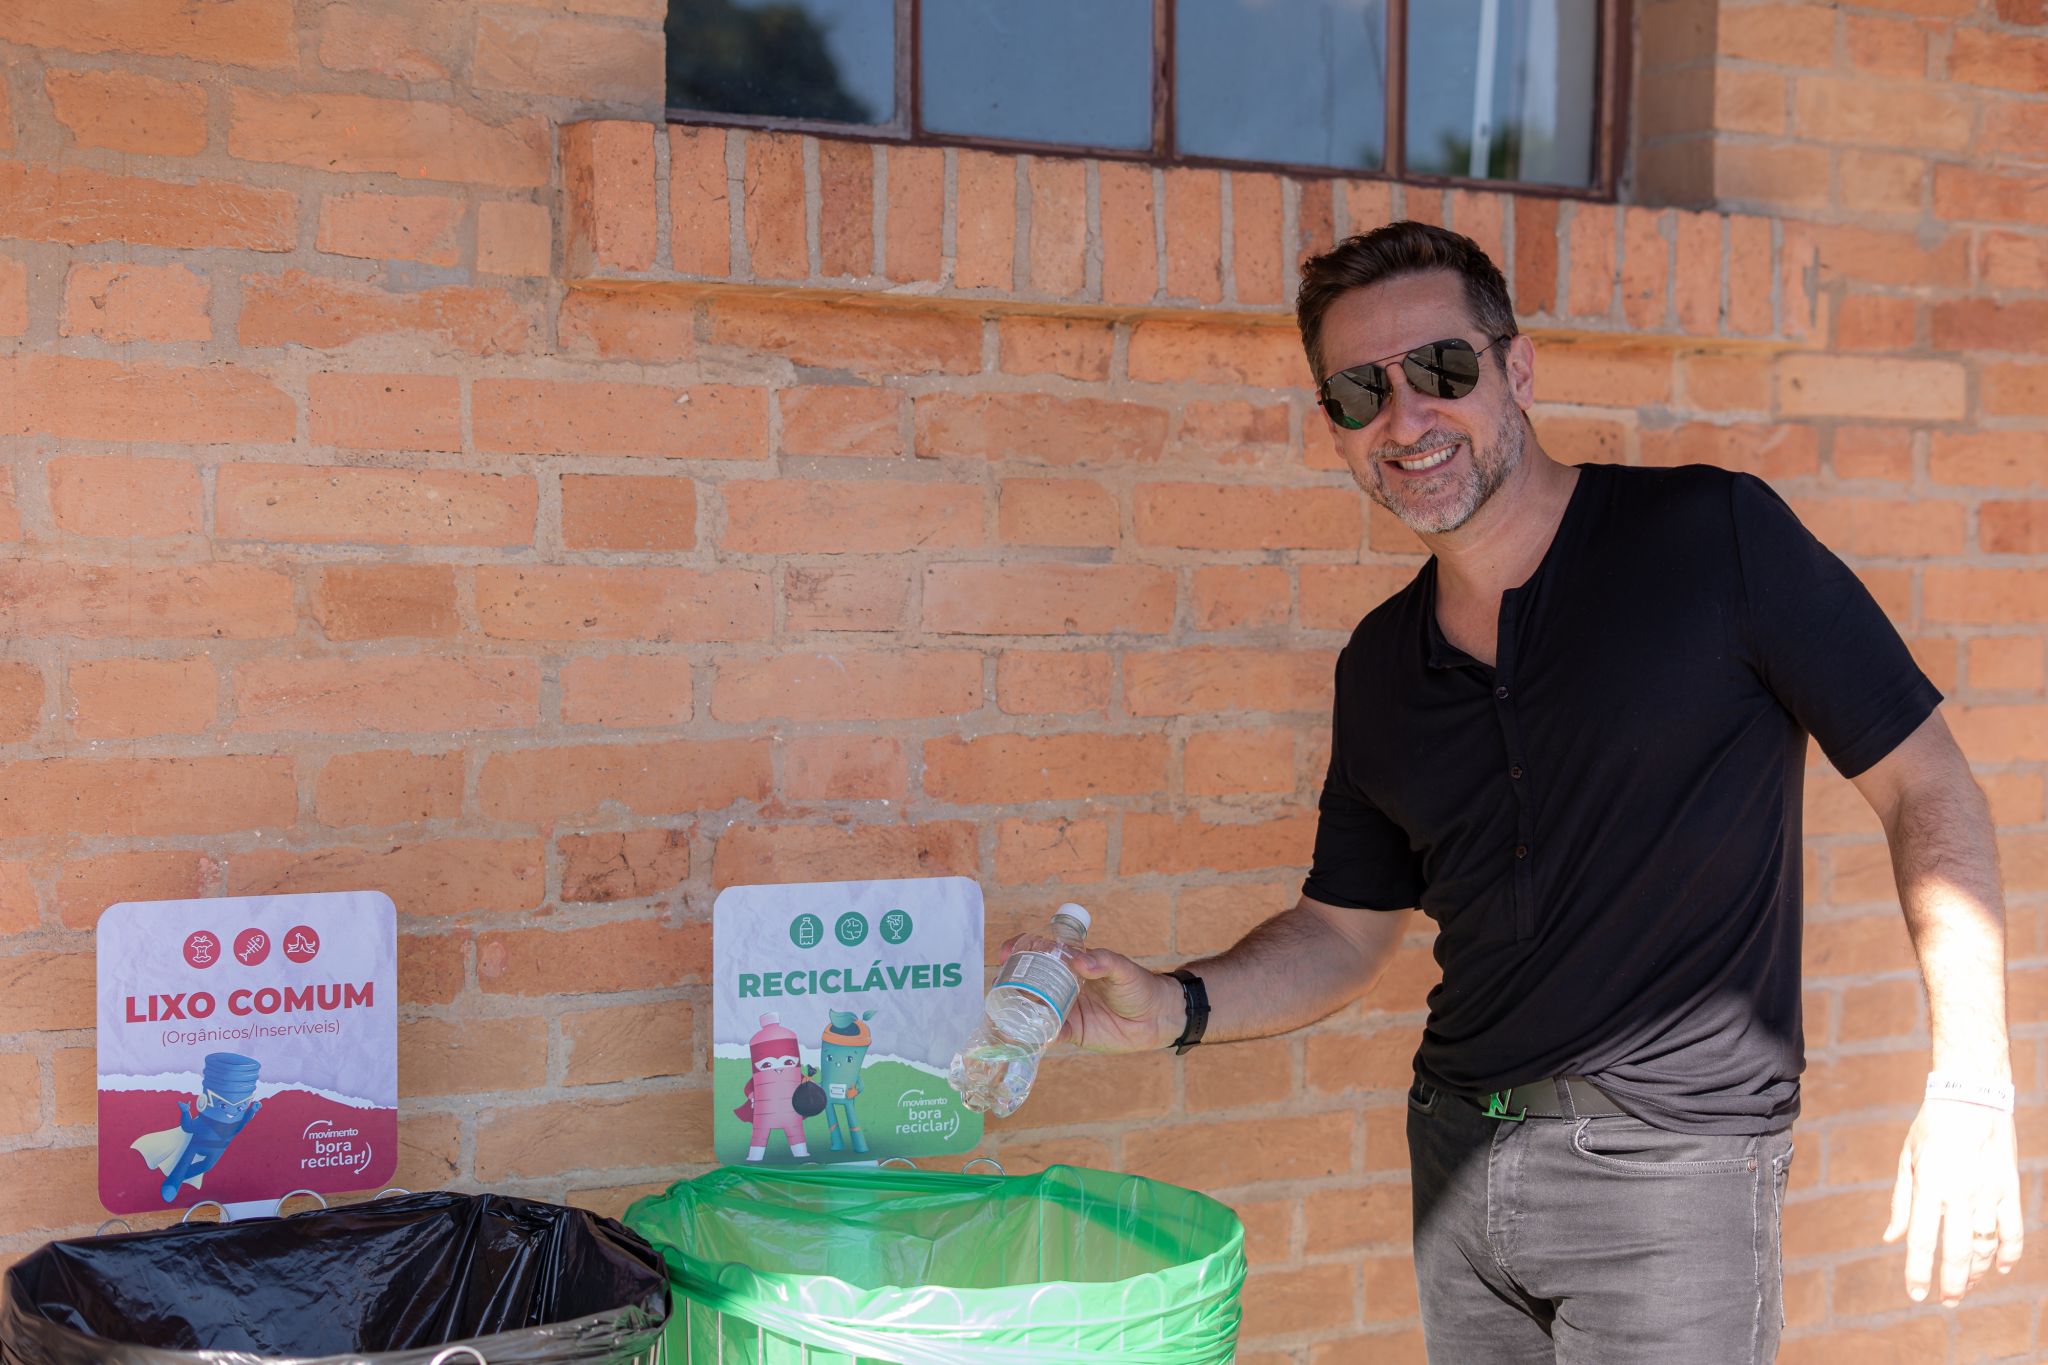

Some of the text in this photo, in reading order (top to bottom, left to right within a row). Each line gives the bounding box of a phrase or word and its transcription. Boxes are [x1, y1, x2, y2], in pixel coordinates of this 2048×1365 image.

[738, 960, 963, 998] RECICLÁVEIS
[125, 982, 374, 1023] LIXO COMUM
[162, 1019, 340, 1047] (Orgânicos/Inservíveis)
[902, 1097, 948, 1108] movimento
[909, 1108, 942, 1121] bora
[308, 1127, 359, 1140] movimento
[895, 1118, 954, 1134] reciclar!
[315, 1140, 352, 1154] bora
[301, 1150, 366, 1169] reciclar!
